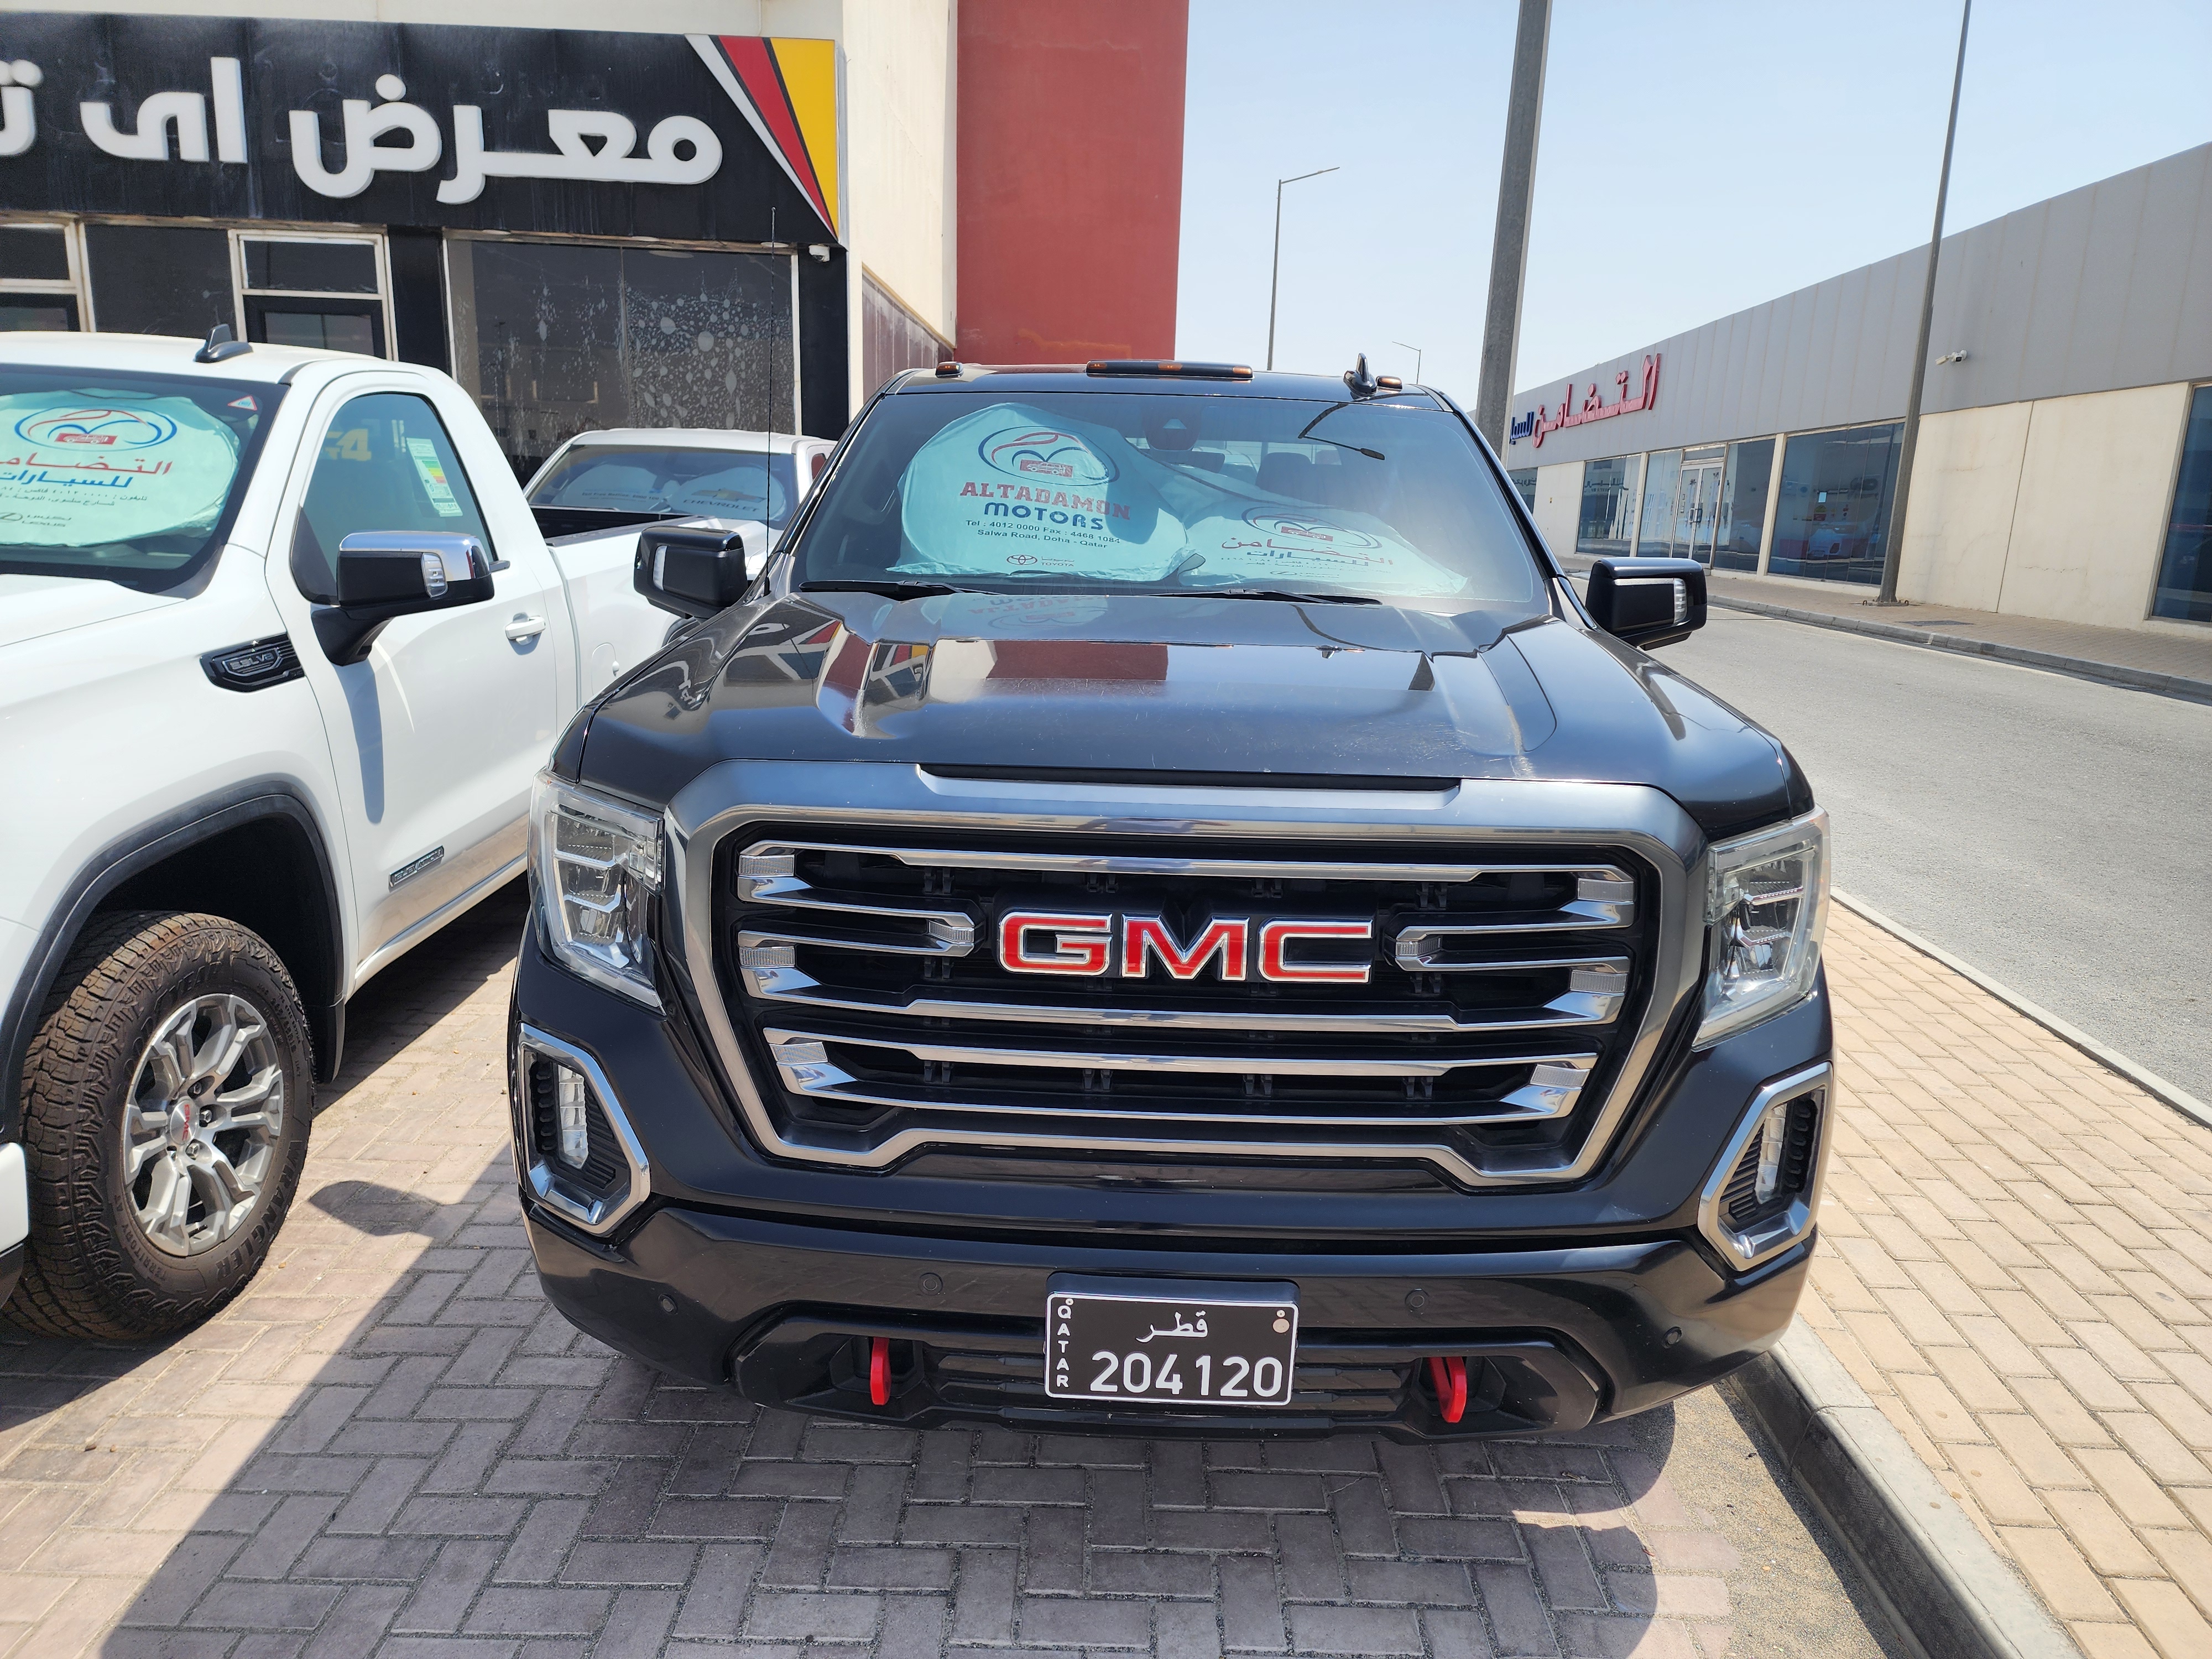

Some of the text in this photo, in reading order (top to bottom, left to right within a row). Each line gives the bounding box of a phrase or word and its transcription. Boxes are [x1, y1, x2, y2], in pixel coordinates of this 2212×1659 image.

[289, 74, 723, 204] معرض
[1532, 353, 1662, 448] التضامن
[0, 451, 173, 476] التضام
[683, 499, 760, 512] CHEVROLET
[959, 482, 1130, 520] ALTADAMON
[984, 502, 1104, 530] MOTORS
[1011, 532, 1040, 540] Road,
[1044, 535, 1070, 544] Doha
[1221, 538, 1394, 565] التضامن
[998, 911, 1374, 984] GMC
[181, 1103, 191, 1141] GMC
[216, 1140, 305, 1280] WRANGLER
[1135, 1310, 1208, 1343] قطر
[1056, 1305, 1072, 1389] QATAR
[1089, 1349, 1283, 1397] 204120
